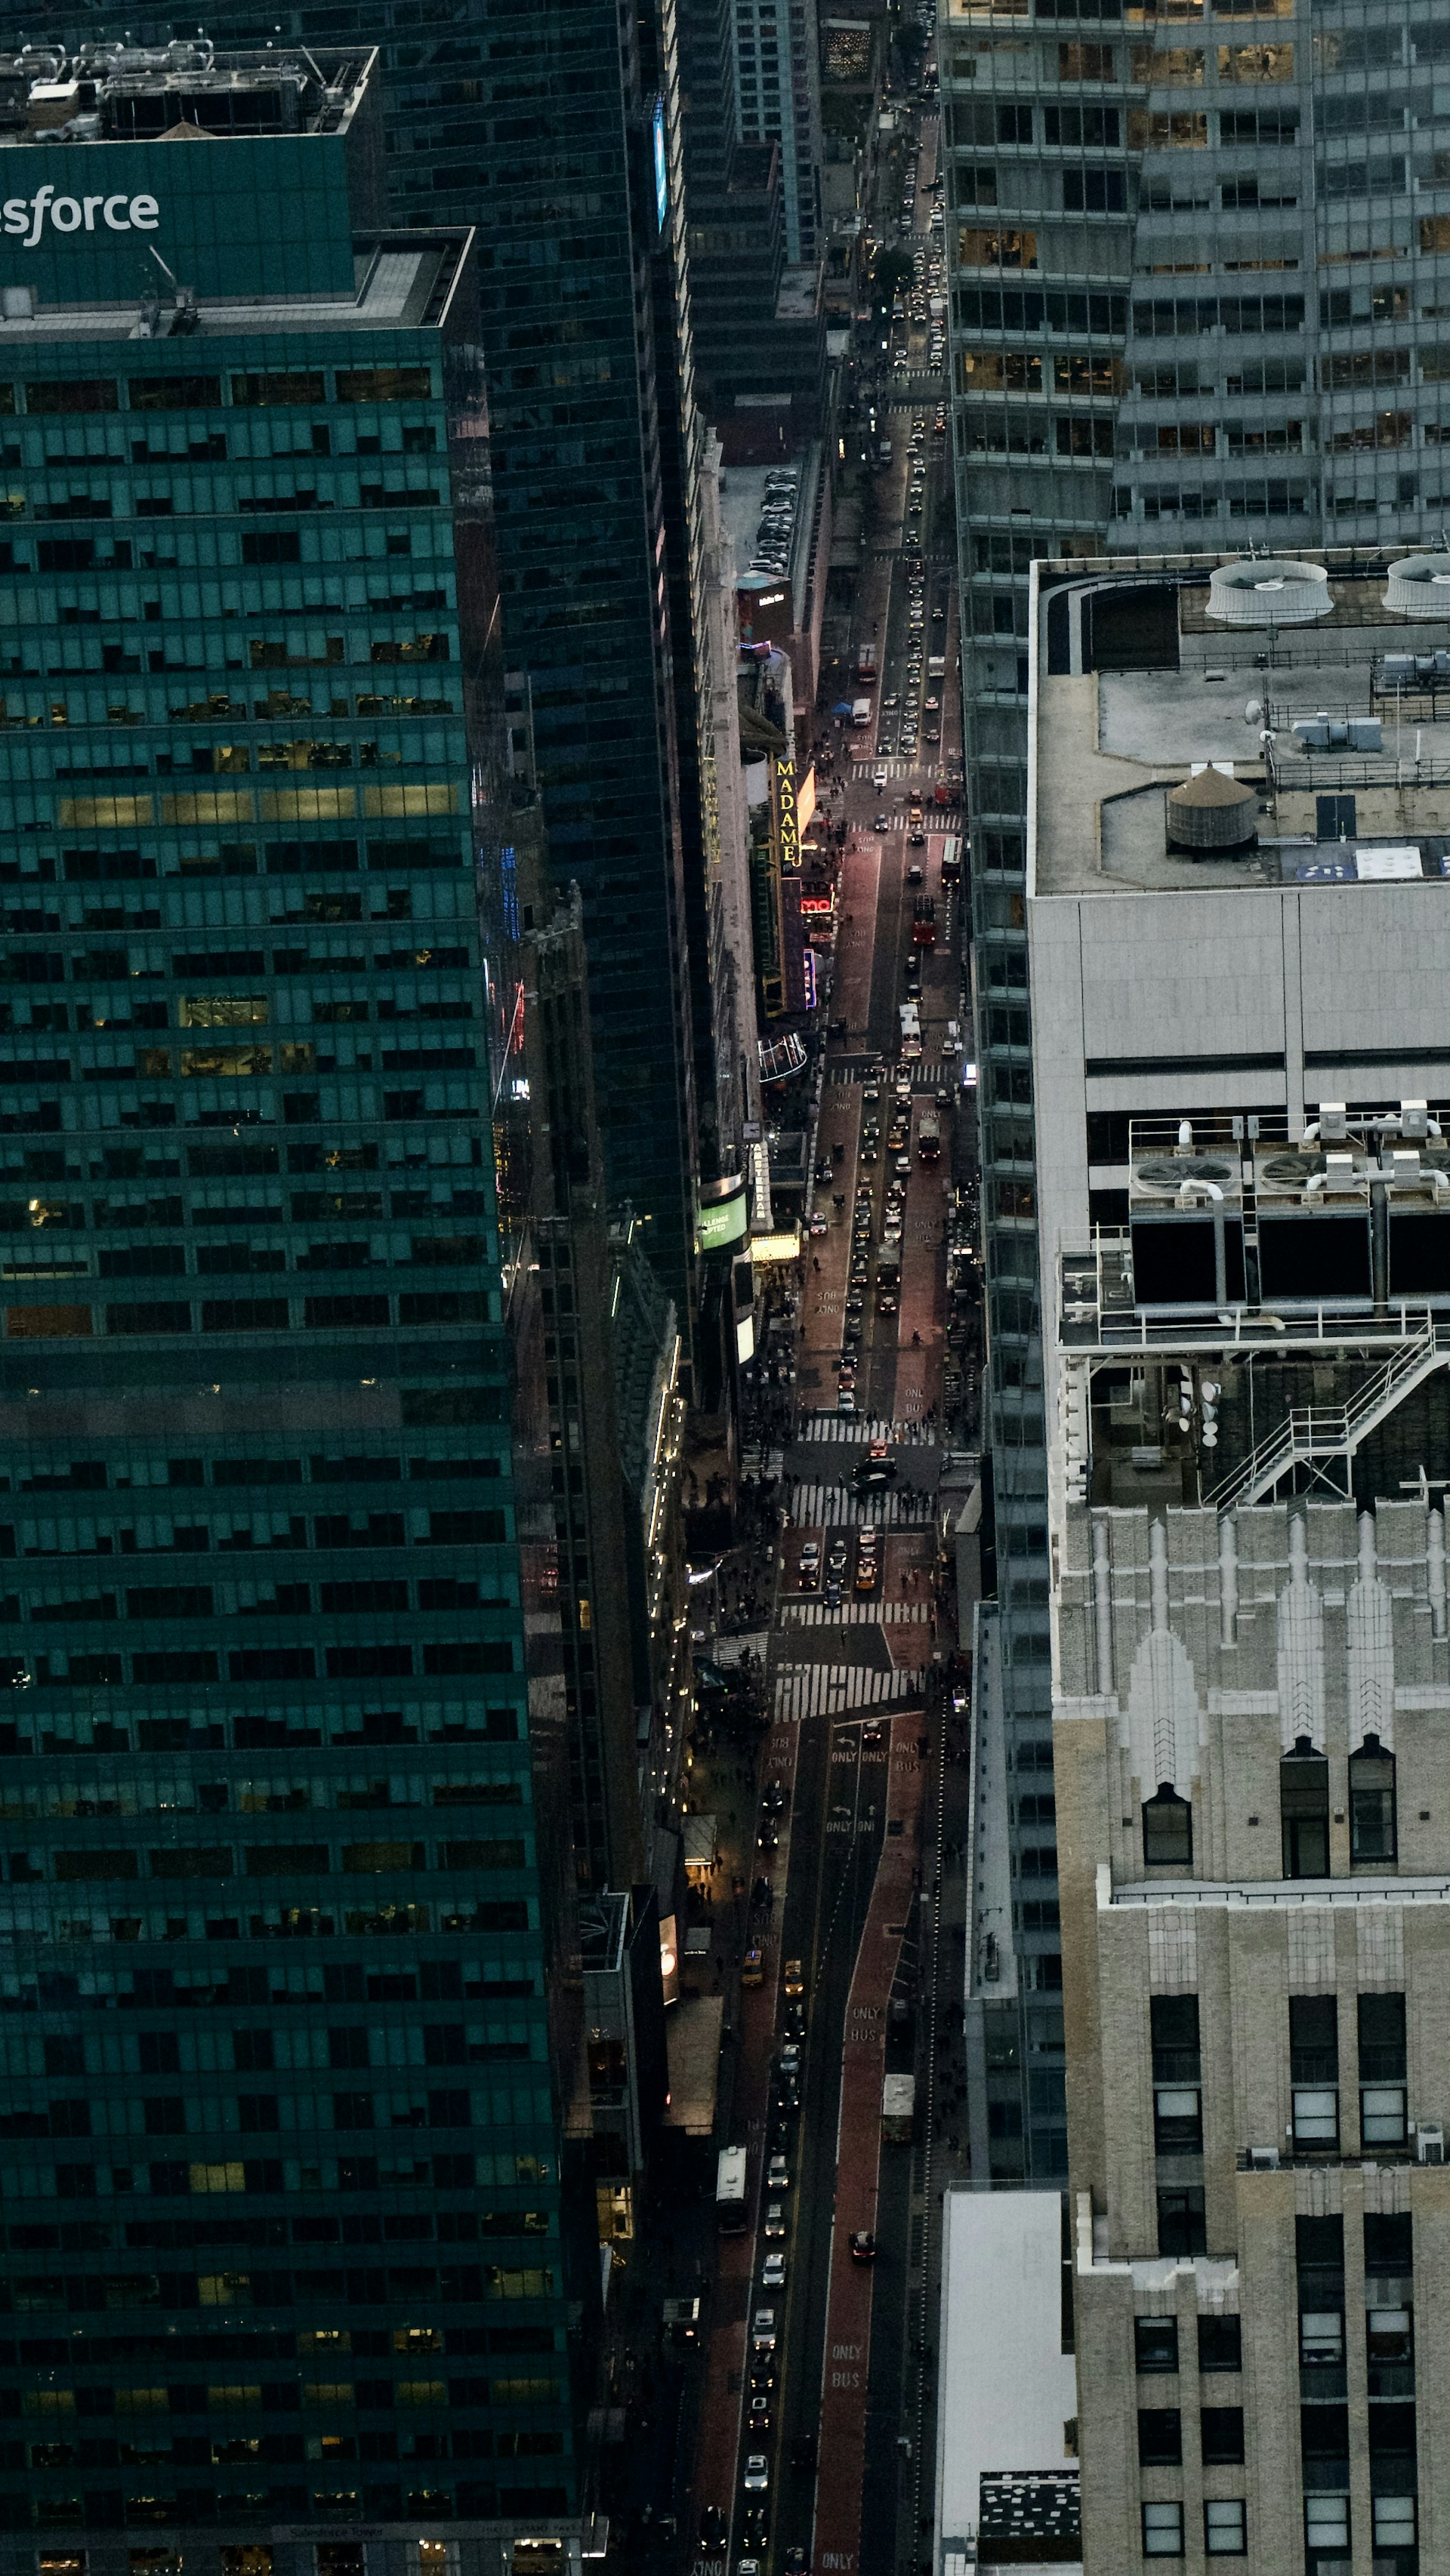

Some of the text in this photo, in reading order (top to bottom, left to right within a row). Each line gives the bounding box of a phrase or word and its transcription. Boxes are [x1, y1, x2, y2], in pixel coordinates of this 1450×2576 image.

[0, 185, 159, 247] sforce
[776, 761, 798, 861] MADAME
[701, 1215, 730, 1227] LLENGE
[767, 1757, 791, 1768] ONLY
[831, 1752, 858, 1763] ONLY
[862, 1751, 888, 1762] ONLY
[896, 1761, 921, 1772] BUS
[826, 1822, 853, 1832] ONLY
[853, 2007, 881, 2020] ONLY
[851, 2029, 876, 2041] BUS
[833, 2345, 864, 2359] ONLY
[833, 2372, 859, 2387] BUS
[822, 2552, 854, 2570] ONLY
